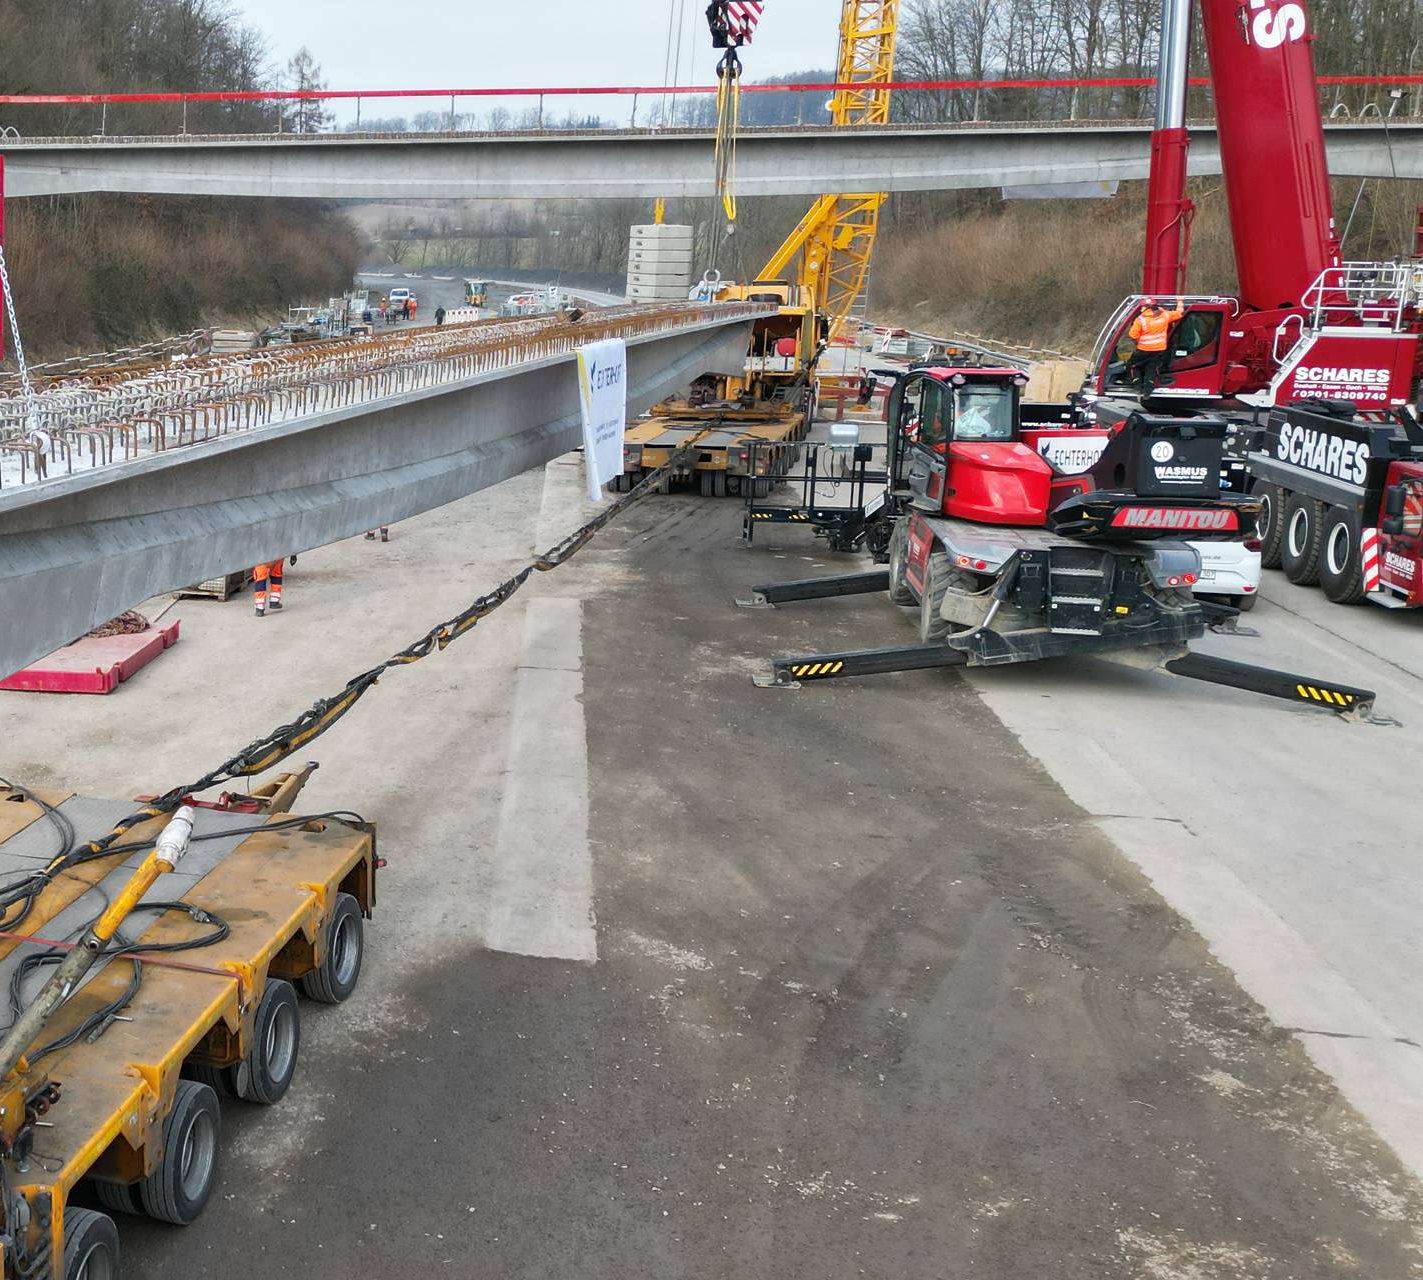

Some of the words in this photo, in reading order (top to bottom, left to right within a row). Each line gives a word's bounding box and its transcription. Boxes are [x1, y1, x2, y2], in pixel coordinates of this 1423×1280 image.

[1295, 366, 1390, 383] SCHARES
[1054, 449, 1103, 467] ECHTERHO
[1155, 445, 1170, 459] 20
[1278, 422, 1370, 485] SCHARES
[1154, 466, 1208, 476] WASMUS
[1123, 508, 1230, 528] MANITOU
[1385, 551, 1416, 573] SCHARES
